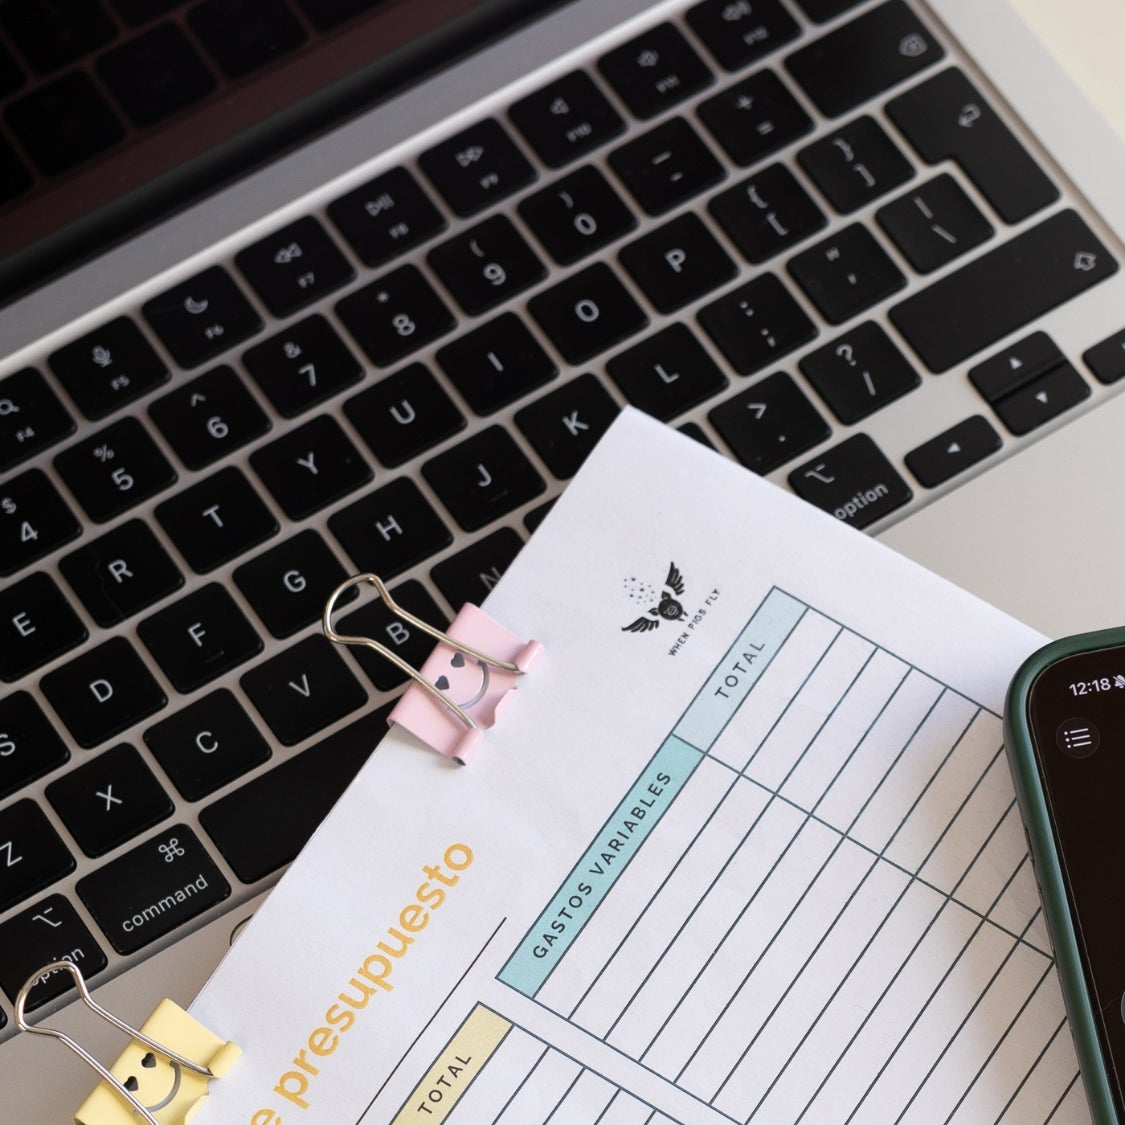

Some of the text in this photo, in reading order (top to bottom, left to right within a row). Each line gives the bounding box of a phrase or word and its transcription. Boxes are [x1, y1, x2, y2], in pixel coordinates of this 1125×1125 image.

[574, 213, 597, 236] 0
[665, 248, 686, 273] P
[483, 263, 506, 286] 9
[575, 299, 600, 323] O
[392, 313, 416, 336] 8
[299, 363, 317, 387] 7
[654, 364, 680, 384] L
[389, 399, 416, 425] U
[562, 411, 589, 436] K
[207, 416, 229, 439] 6
[297, 452, 318, 475] Y
[477, 464, 492, 487] J
[111, 467, 134, 491] 5
[833, 482, 889, 520] option
[202, 505, 224, 528] T
[375, 515, 403, 541] H
[21, 521, 38, 542] 4
[108, 559, 133, 583] R
[283, 570, 307, 593] G
[12, 612, 36, 637] E
[386, 622, 410, 645] B
[667, 587, 721, 657] WHEN PIGS FLY
[187, 622, 206, 647] F
[714, 641, 766, 700] TOTAL
[89, 679, 114, 703] D
[288, 673, 311, 697] V
[1069, 677, 1112, 697] 12:18
[0, 733, 16, 757] S
[195, 731, 219, 754] C
[95, 784, 123, 811] X
[0, 841, 23, 867] Z
[532, 771, 671, 959] GASTOS VARIABLES
[122, 875, 208, 932] command
[272, 842, 475, 1109] presupuesto
[416, 1051, 473, 1117] TOTAL
